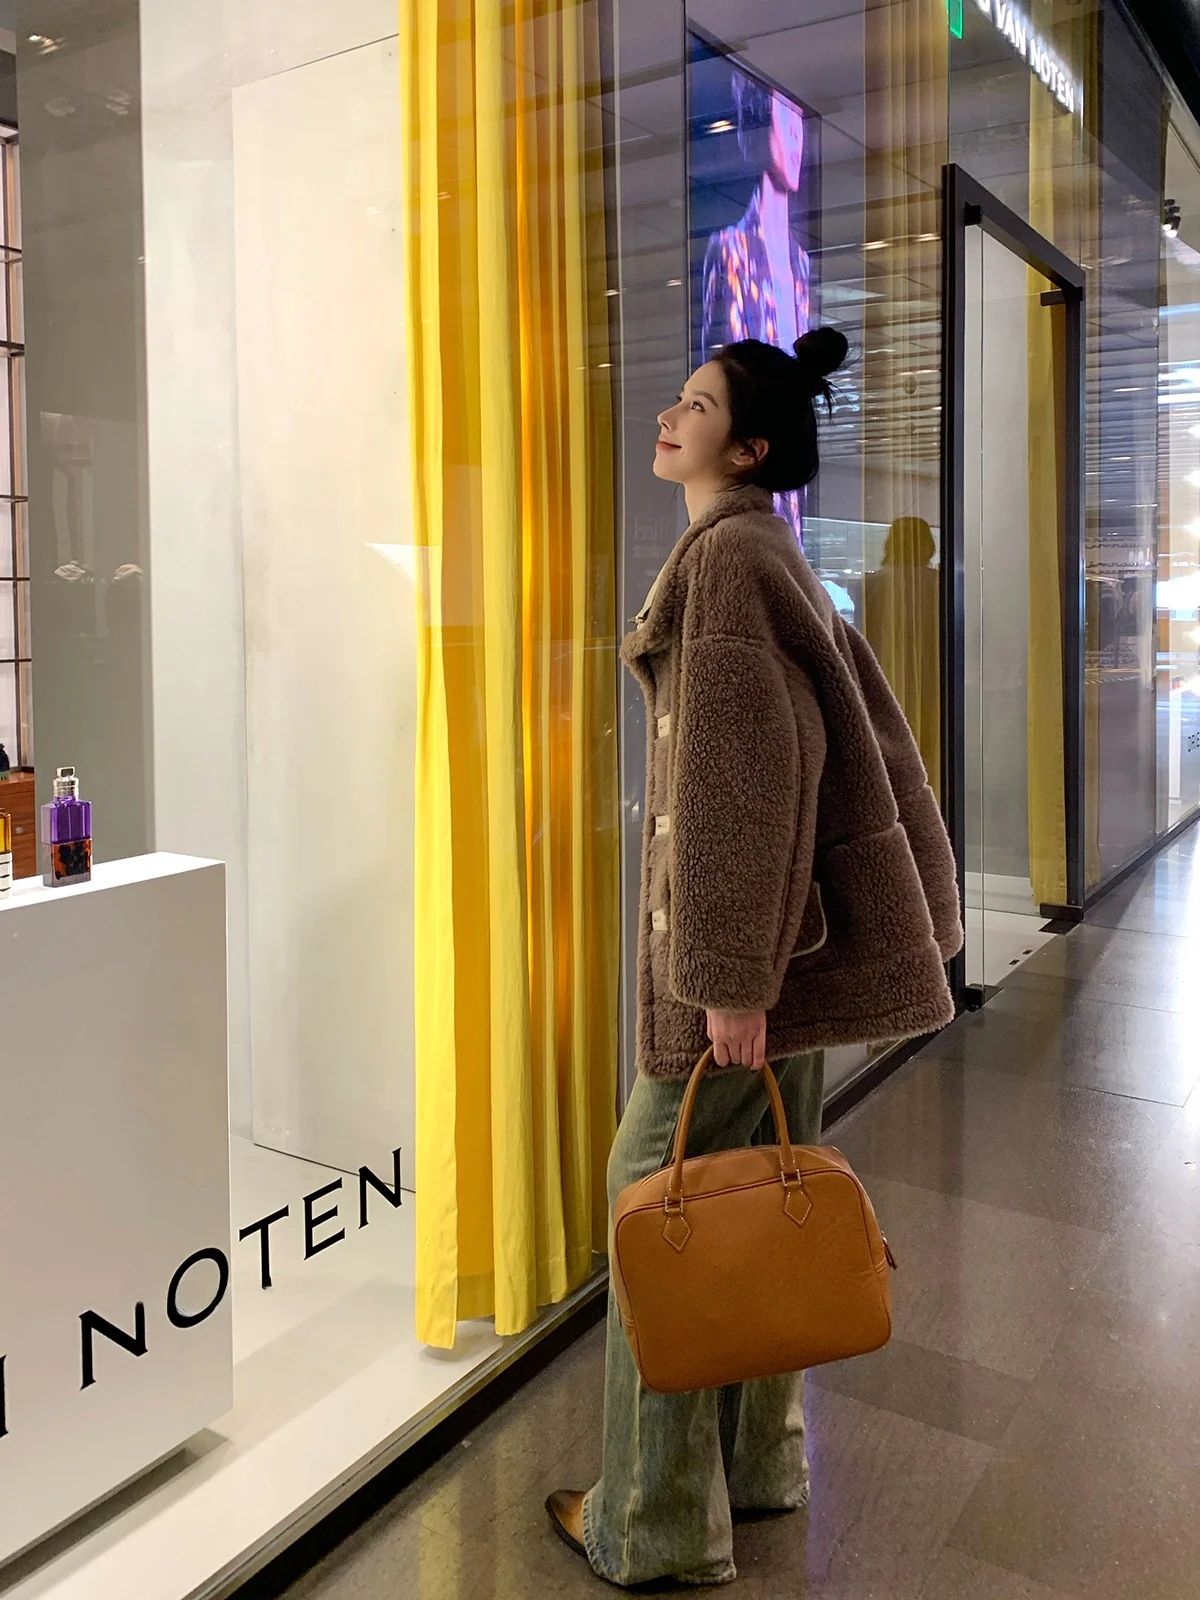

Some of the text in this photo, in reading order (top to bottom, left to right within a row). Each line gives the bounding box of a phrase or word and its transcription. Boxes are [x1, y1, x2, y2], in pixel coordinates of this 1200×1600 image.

[996, 0, 1074, 113] VAN NOTEN
[79, 1147, 402, 1391] NOTEN
